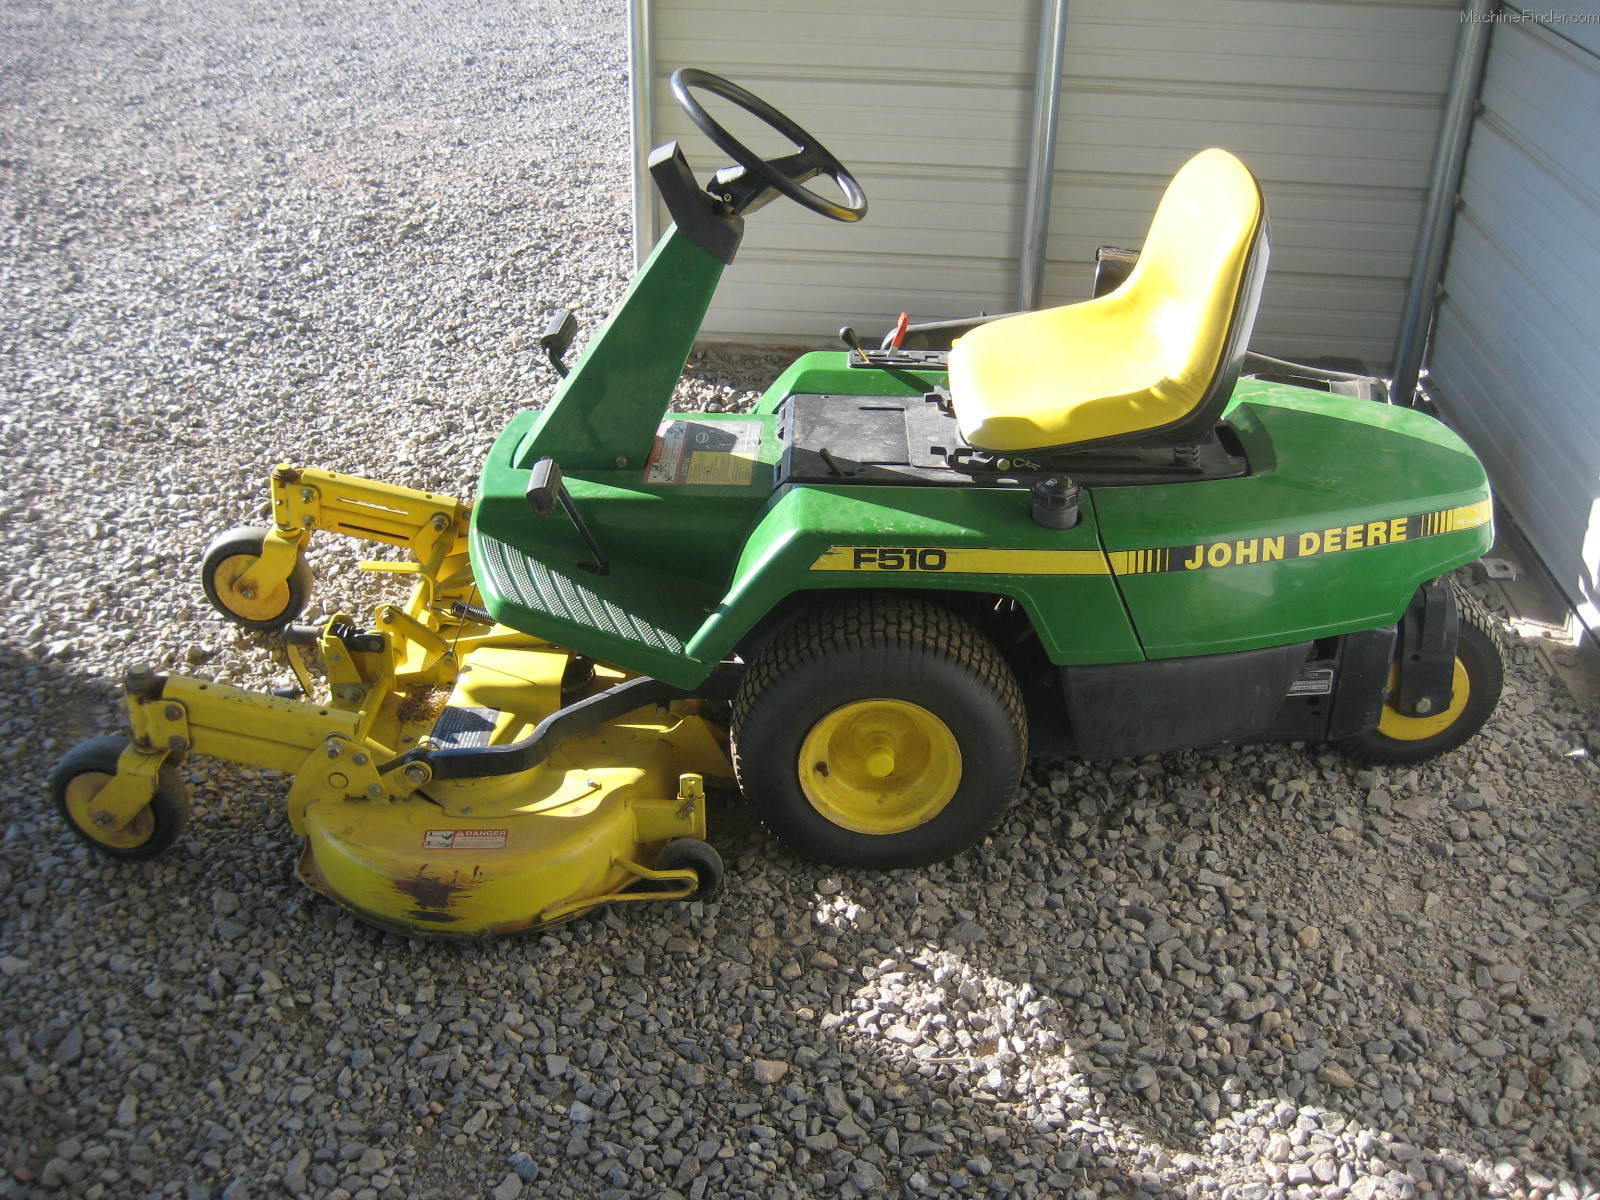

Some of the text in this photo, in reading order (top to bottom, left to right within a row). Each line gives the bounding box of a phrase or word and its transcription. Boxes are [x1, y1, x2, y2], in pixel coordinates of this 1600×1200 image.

[853, 548, 947, 571] F510
[1184, 517, 1409, 570] JOHN DEERE
